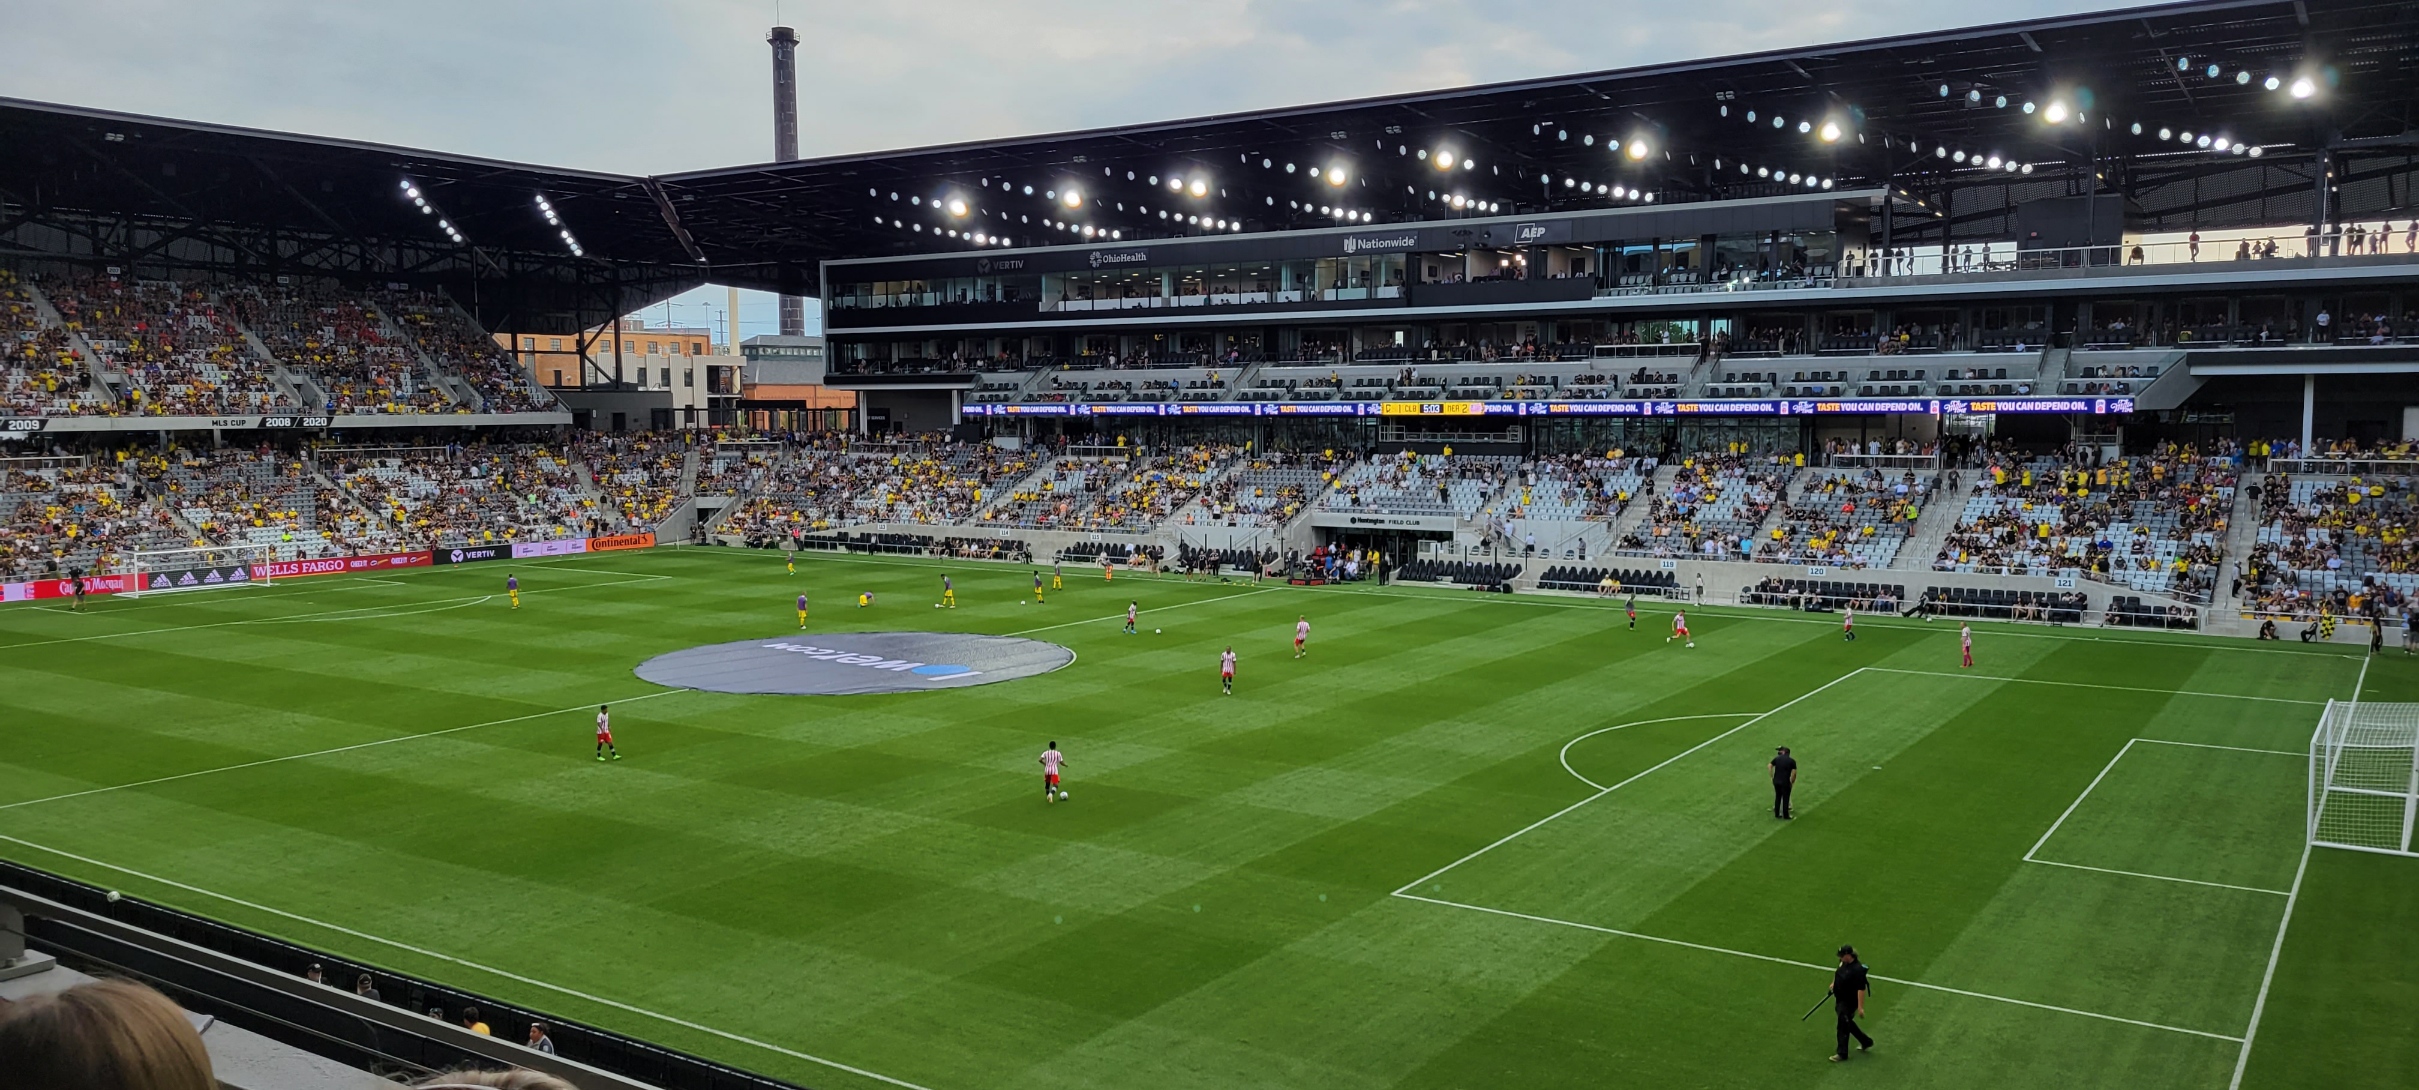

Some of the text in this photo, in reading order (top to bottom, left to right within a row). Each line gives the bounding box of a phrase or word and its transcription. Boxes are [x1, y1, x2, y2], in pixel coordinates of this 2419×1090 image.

[1520, 227, 1546, 239] AEP
[1357, 235, 1415, 250] Nationwide
[1102, 252, 1147, 264] OhioHealth
[993, 260, 1024, 270] VERTIV
[1423, 404, 1440, 413] 5:03
[1462, 404, 1468, 413] 2
[1502, 404, 1514, 412] ON.
[1549, 404, 1569, 412] TASTE
[1570, 404, 1584, 412] YOU
[1584, 404, 1598, 412] CAN
[1598, 404, 1625, 412] DEPEND
[1626, 404, 1638, 412] ON.
[1677, 403, 1774, 412] TASTE YOU CAN DEPEND ON.
[1817, 402, 1923, 411] TASTE YOU CAN DEPEND ON.
[1970, 401, 2088, 411] TASTE YOU CAN DEPEND ON.
[8, 420, 40, 431] 2009
[212, 419, 246, 427] MLS CUP
[266, 418, 291, 427] 2008
[303, 417, 328, 427] 2020
[591, 536, 641, 551] Continental
[465, 550, 495, 559] VERTIV
[254, 560, 345, 577] WELLS FARGO
[90, 578, 123, 593] Morgan
[2057, 579, 2072, 587] 121
